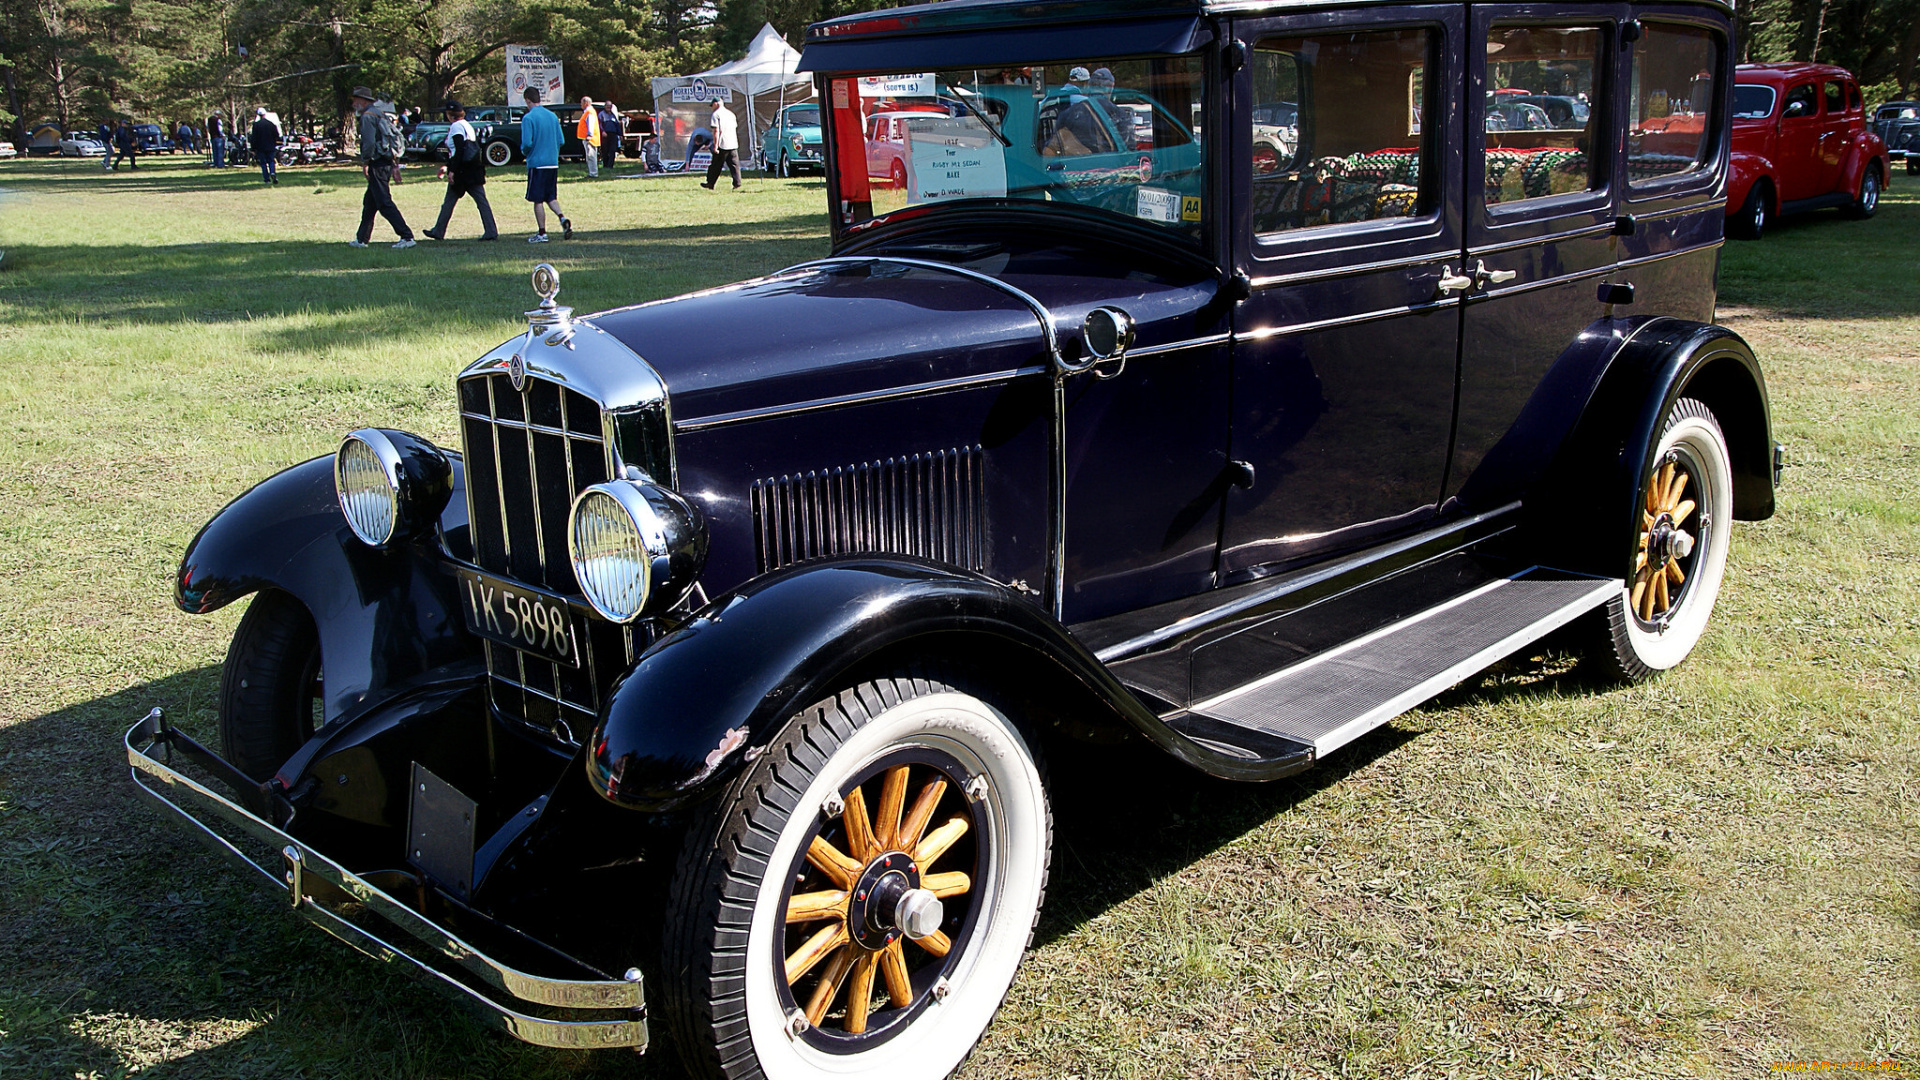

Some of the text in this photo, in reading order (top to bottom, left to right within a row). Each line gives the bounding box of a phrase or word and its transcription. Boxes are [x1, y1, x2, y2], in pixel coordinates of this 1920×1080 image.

[674, 87, 728, 95] MORRIS OWNERS
[1185, 200, 1199, 213] AA
